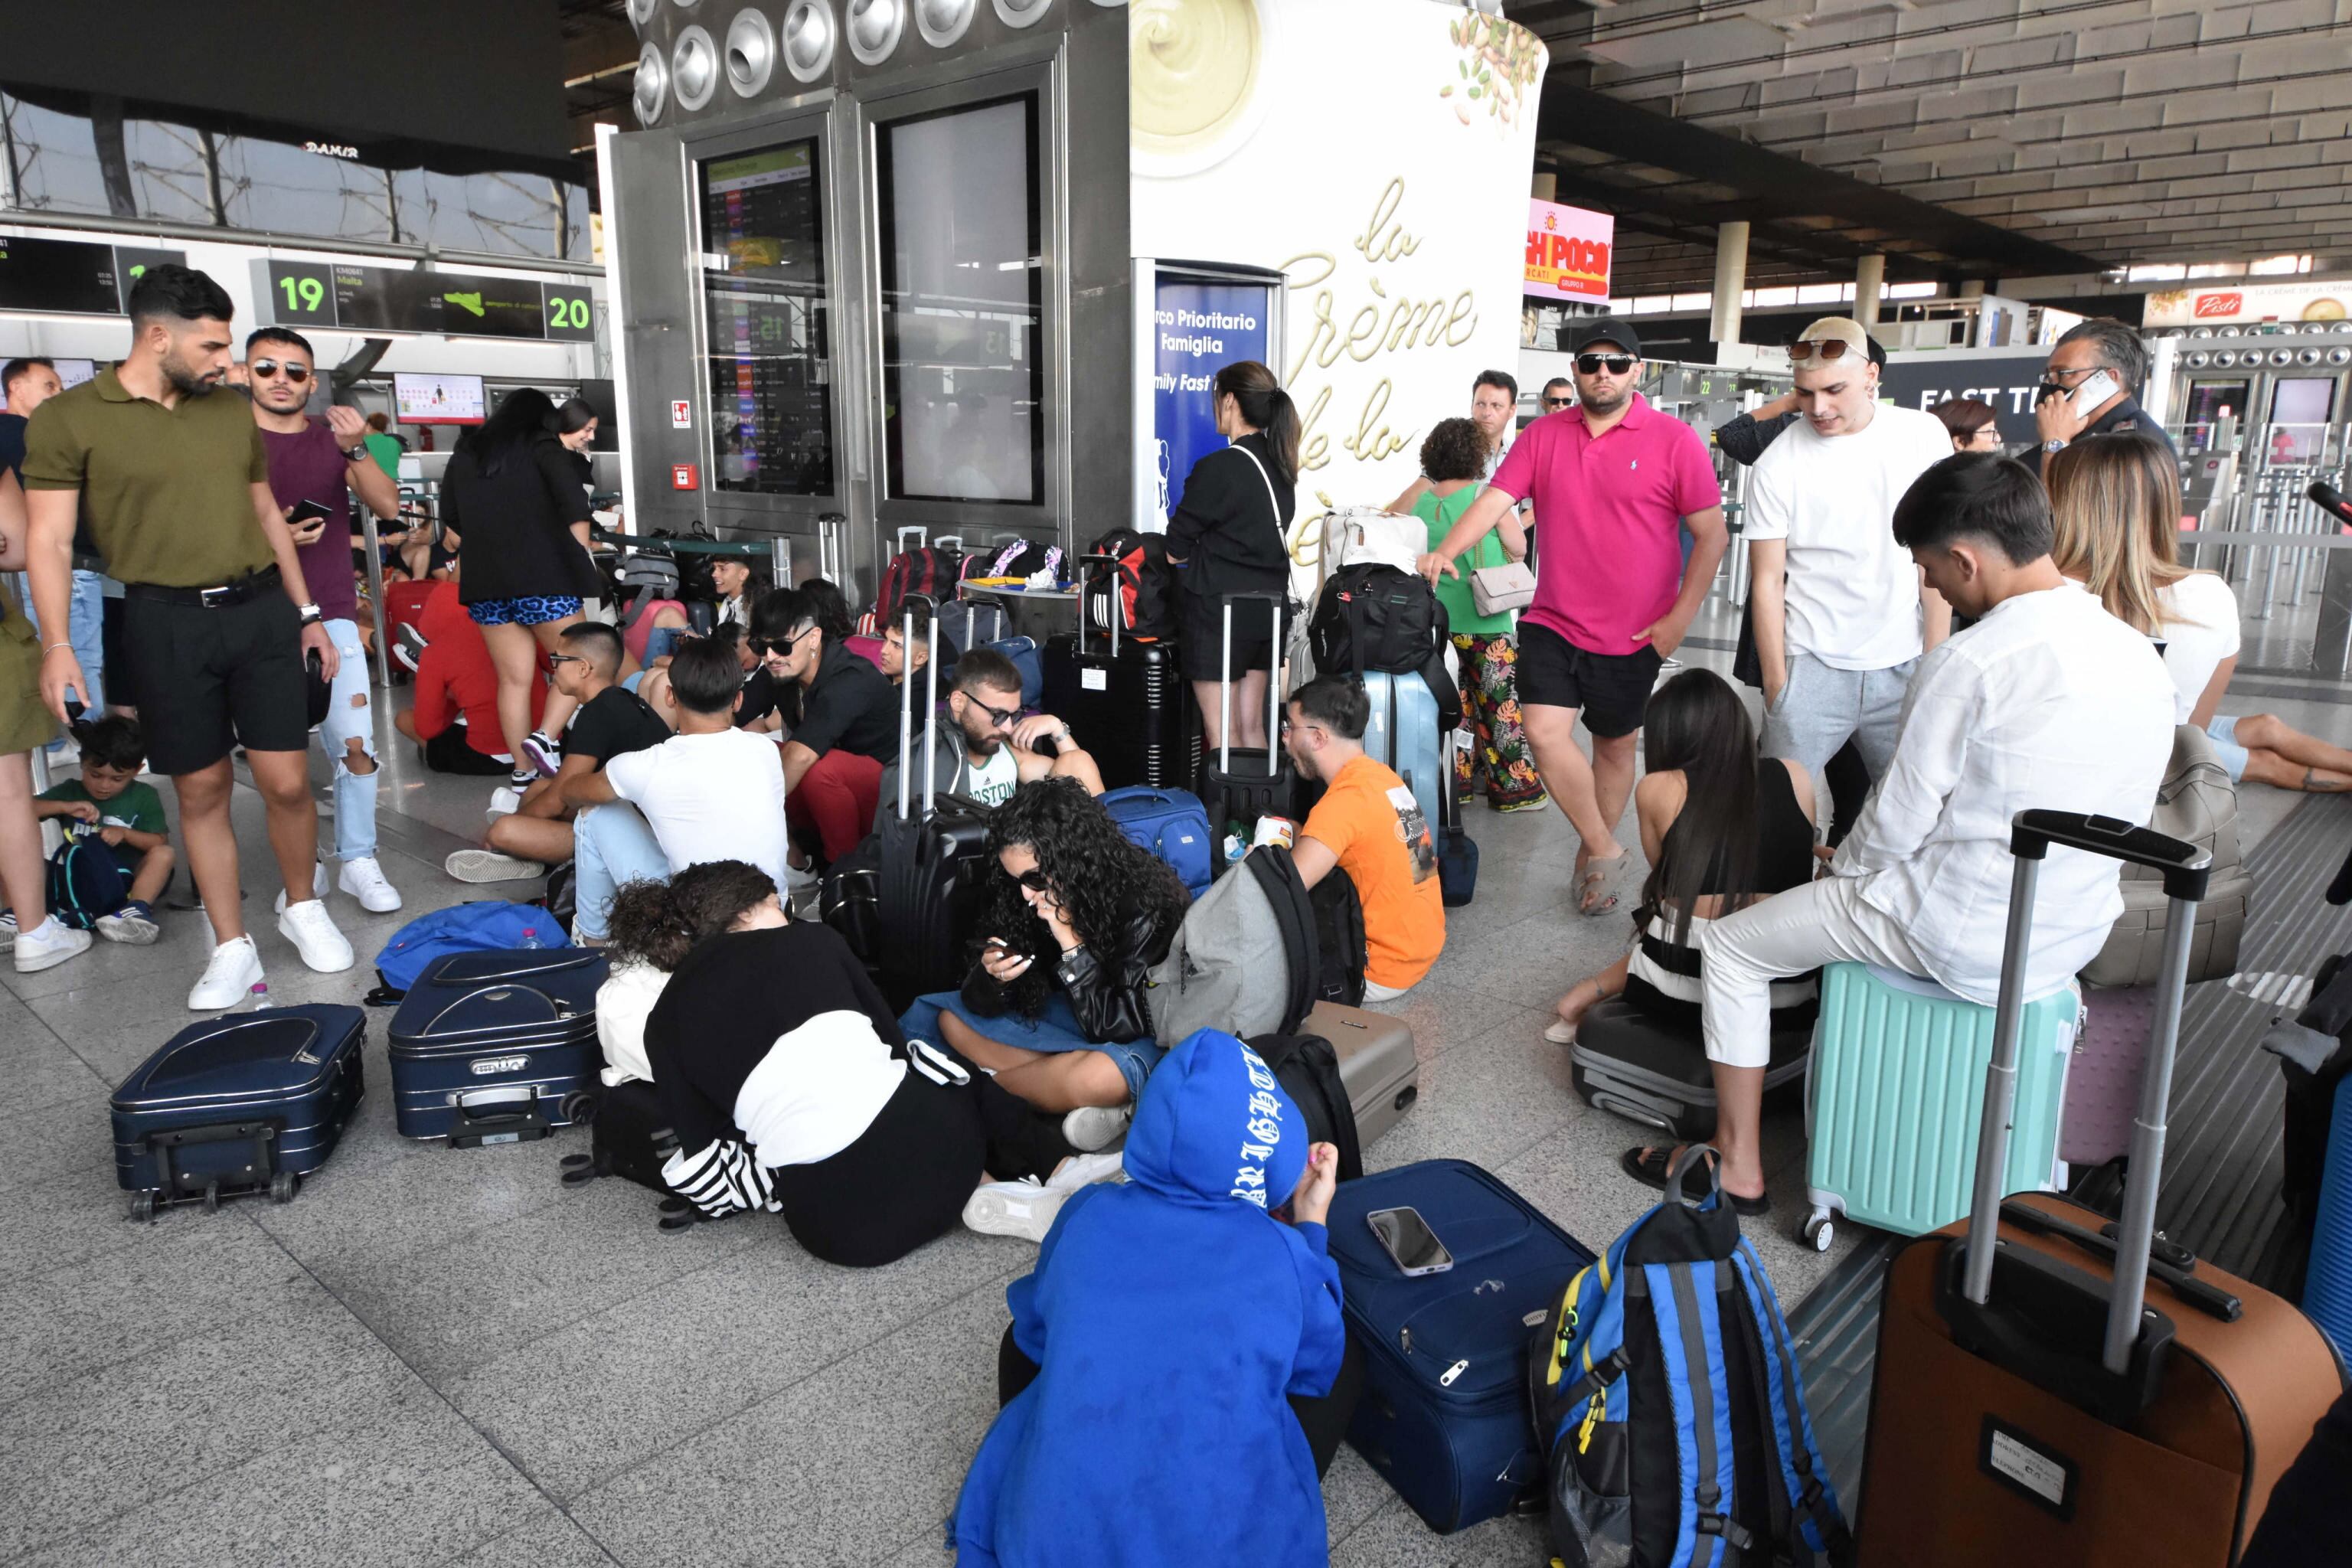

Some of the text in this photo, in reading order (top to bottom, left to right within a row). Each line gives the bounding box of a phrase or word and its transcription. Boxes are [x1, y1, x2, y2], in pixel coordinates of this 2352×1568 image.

[1353, 175, 1426, 263] la
[280, 276, 324, 312] 19
[2197, 296, 2239, 316] Pisti
[549, 297, 589, 329] 20
[1178, 309, 1256, 331] Prioritario
[1161, 333, 1223, 358] Famiglia
[1180, 374, 1210, 391] Fast
[1701, 381, 1710, 395] 22
[1343, 377, 1420, 461] la
